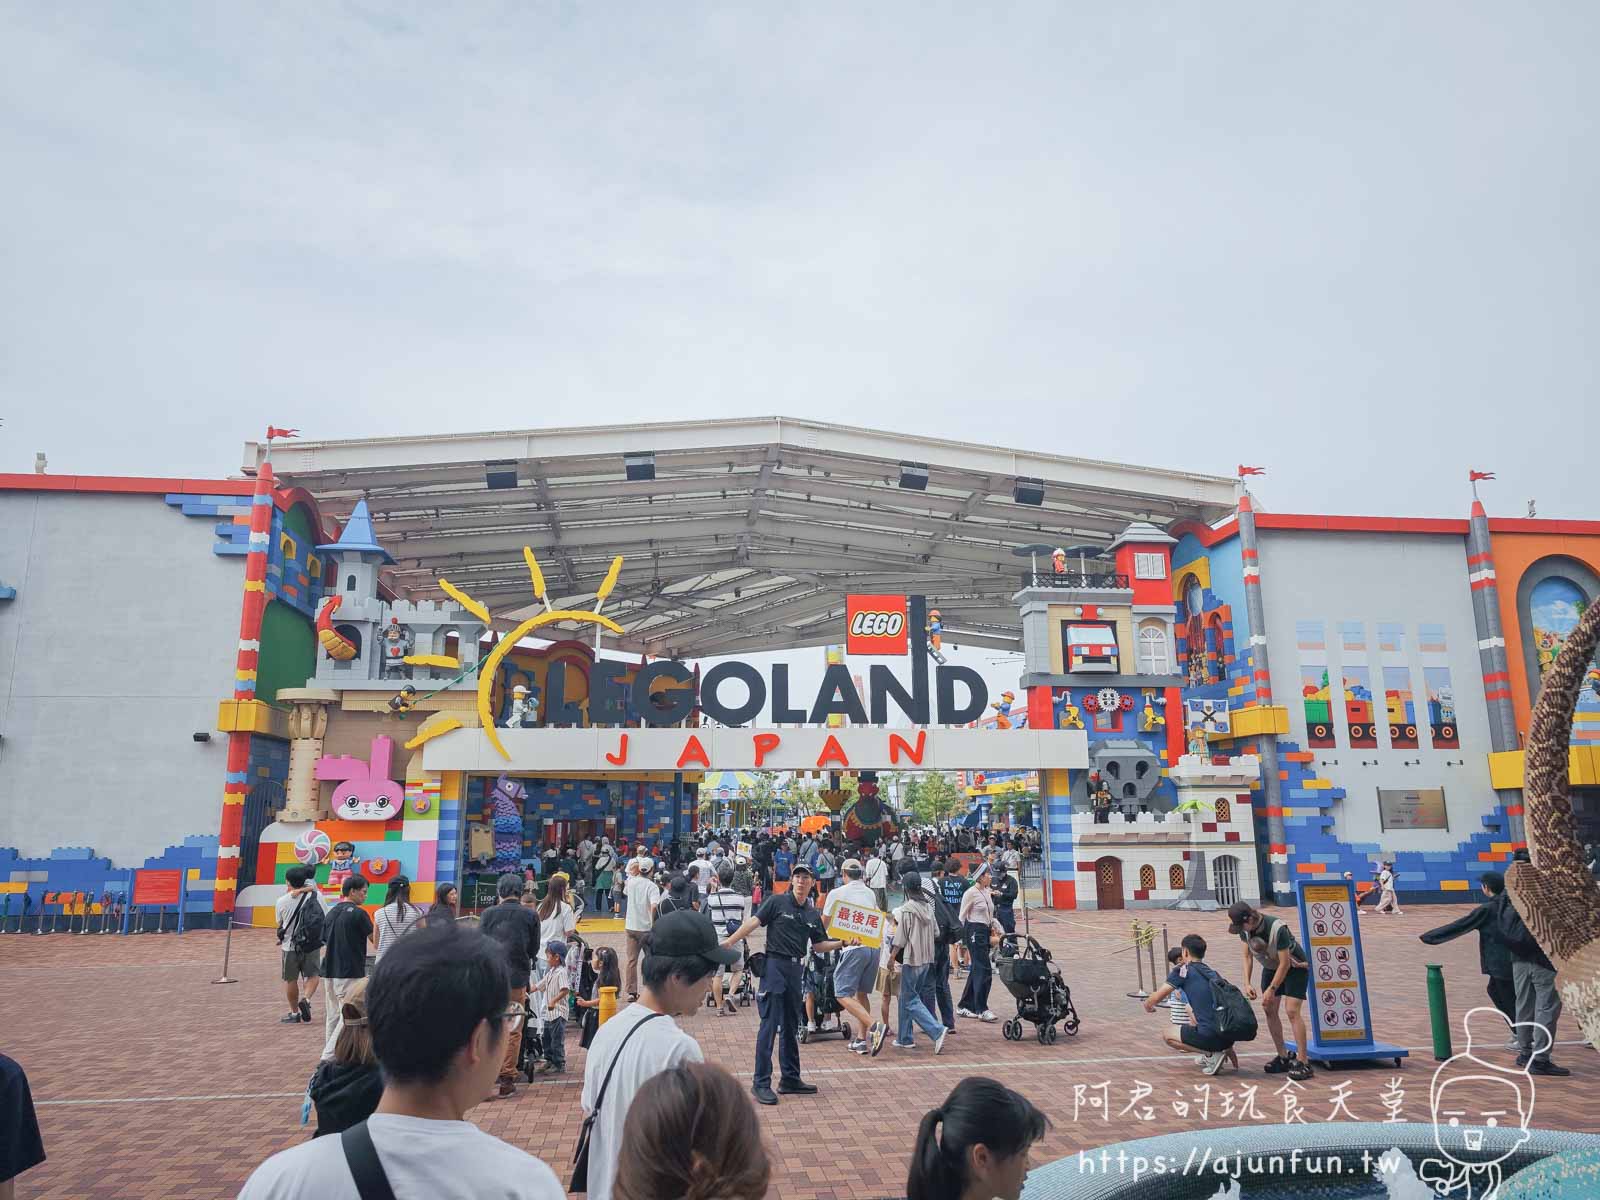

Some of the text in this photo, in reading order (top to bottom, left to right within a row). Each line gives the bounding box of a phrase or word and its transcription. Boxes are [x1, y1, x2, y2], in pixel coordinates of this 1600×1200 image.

[852, 612, 903, 635] LEGO
[547, 595, 988, 726] LEGOLAND
[605, 730, 926, 768] JAPAN
[838, 906, 879, 929] 最後尾
